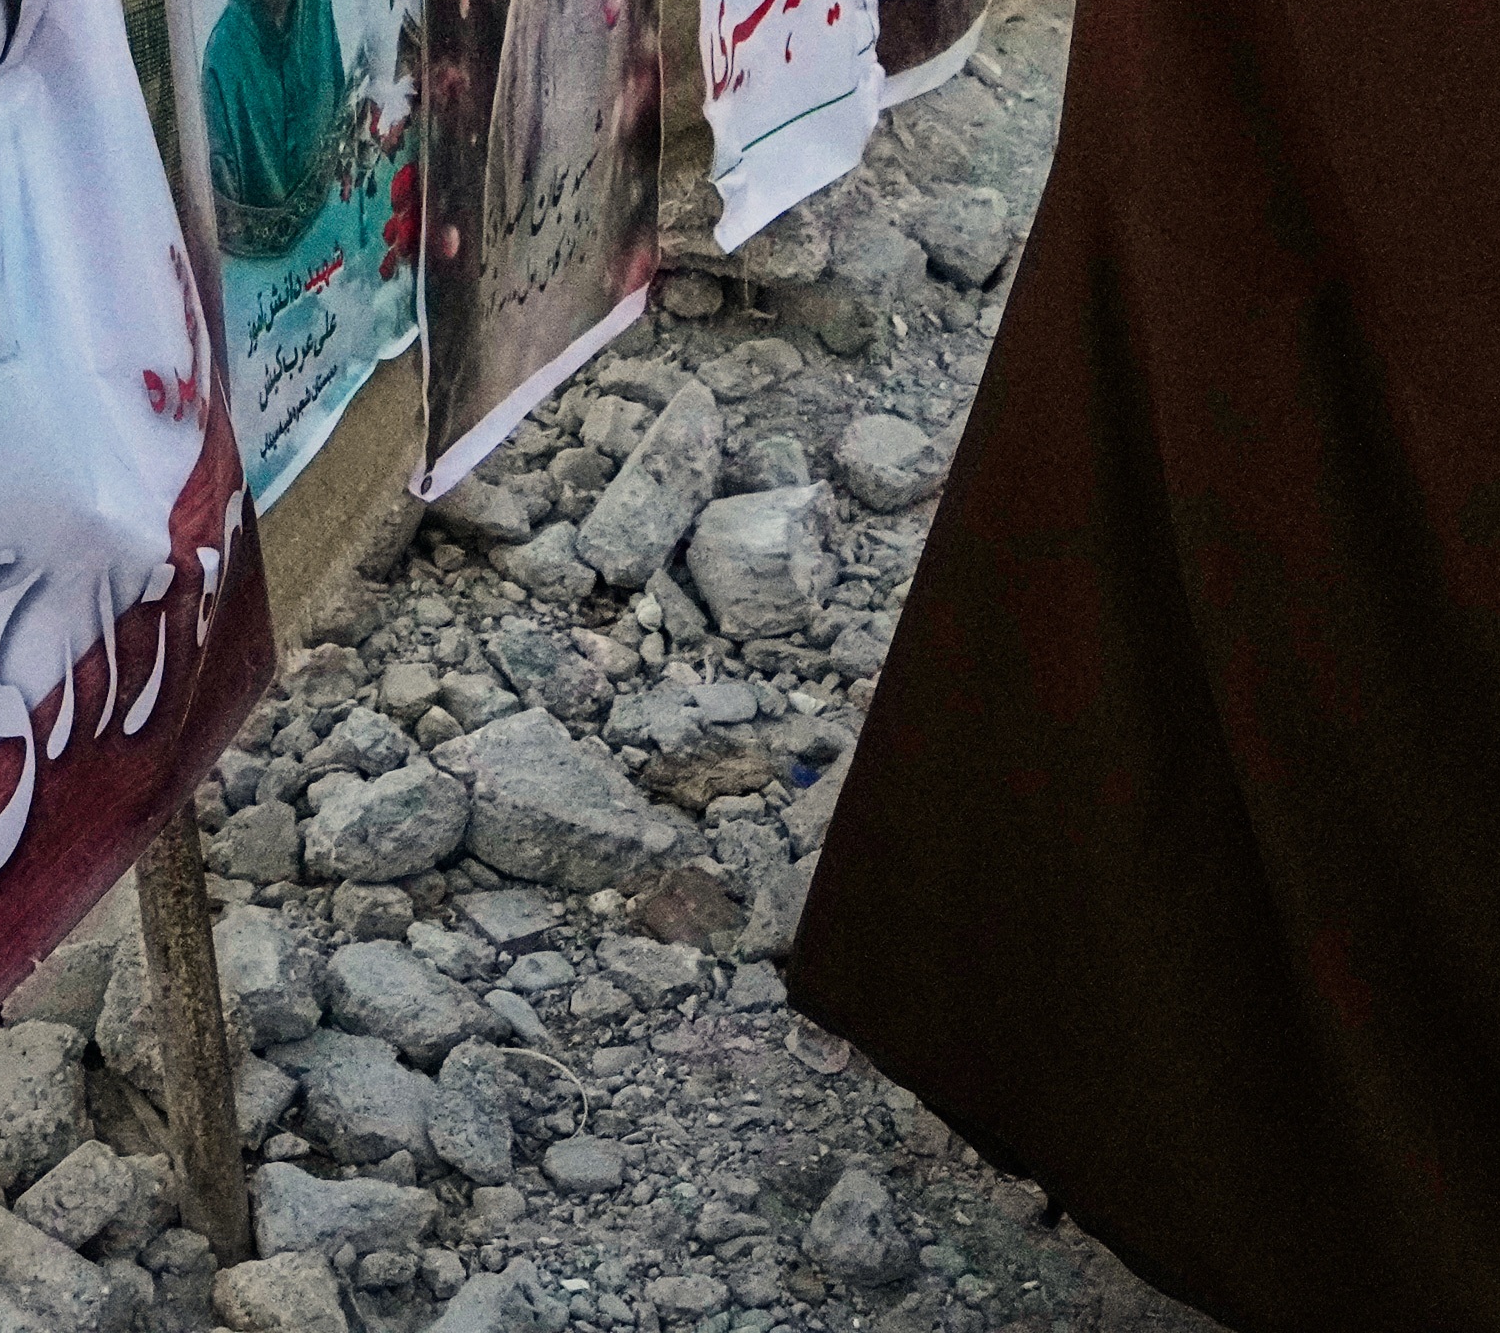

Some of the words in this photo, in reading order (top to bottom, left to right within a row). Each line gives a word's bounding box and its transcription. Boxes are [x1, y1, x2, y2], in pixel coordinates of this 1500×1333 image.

[303, 239, 345, 295] شهید
[266, 269, 302, 333] دانش
[282, 331, 313, 381] عرب
[313, 309, 337, 359] علی
